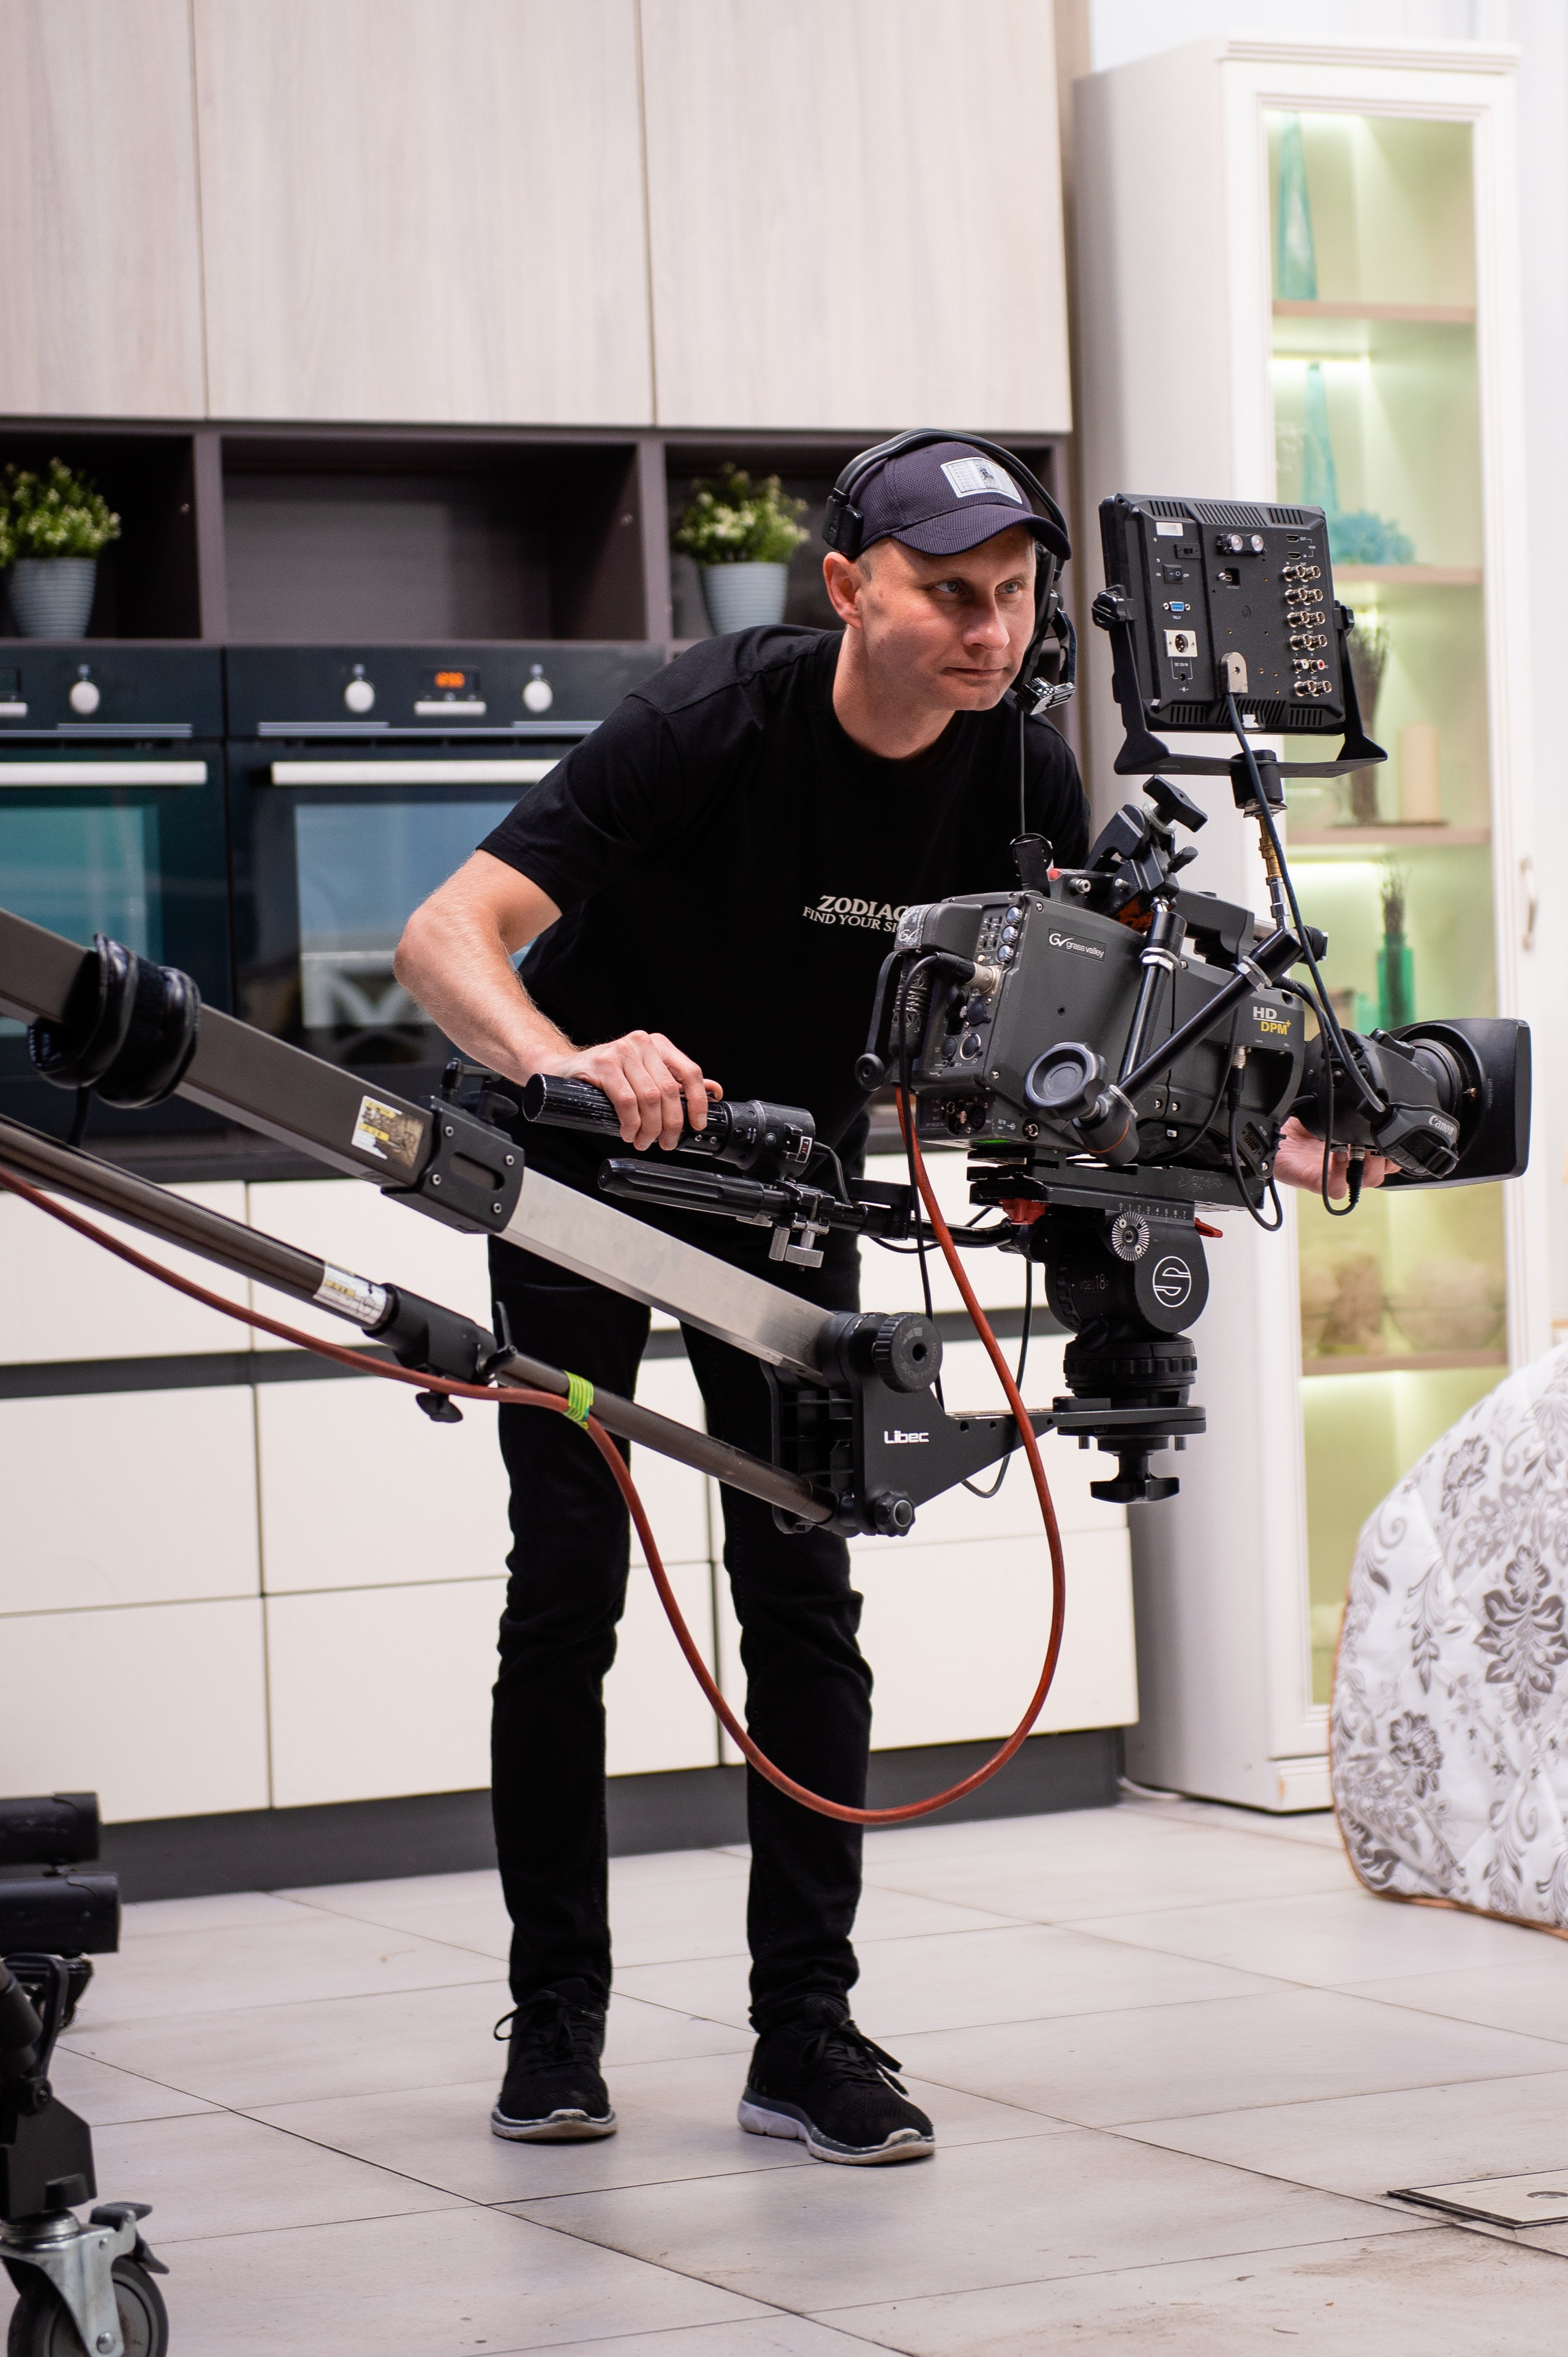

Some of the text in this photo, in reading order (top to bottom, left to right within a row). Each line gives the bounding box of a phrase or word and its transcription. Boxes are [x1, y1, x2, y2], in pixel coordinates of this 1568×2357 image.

[802, 906, 900, 933] FIND YOUR SI
[1253, 1006, 1278, 1020] HD
[1428, 1115, 1455, 1136] Canon
[884, 1430, 930, 1444] Libec
